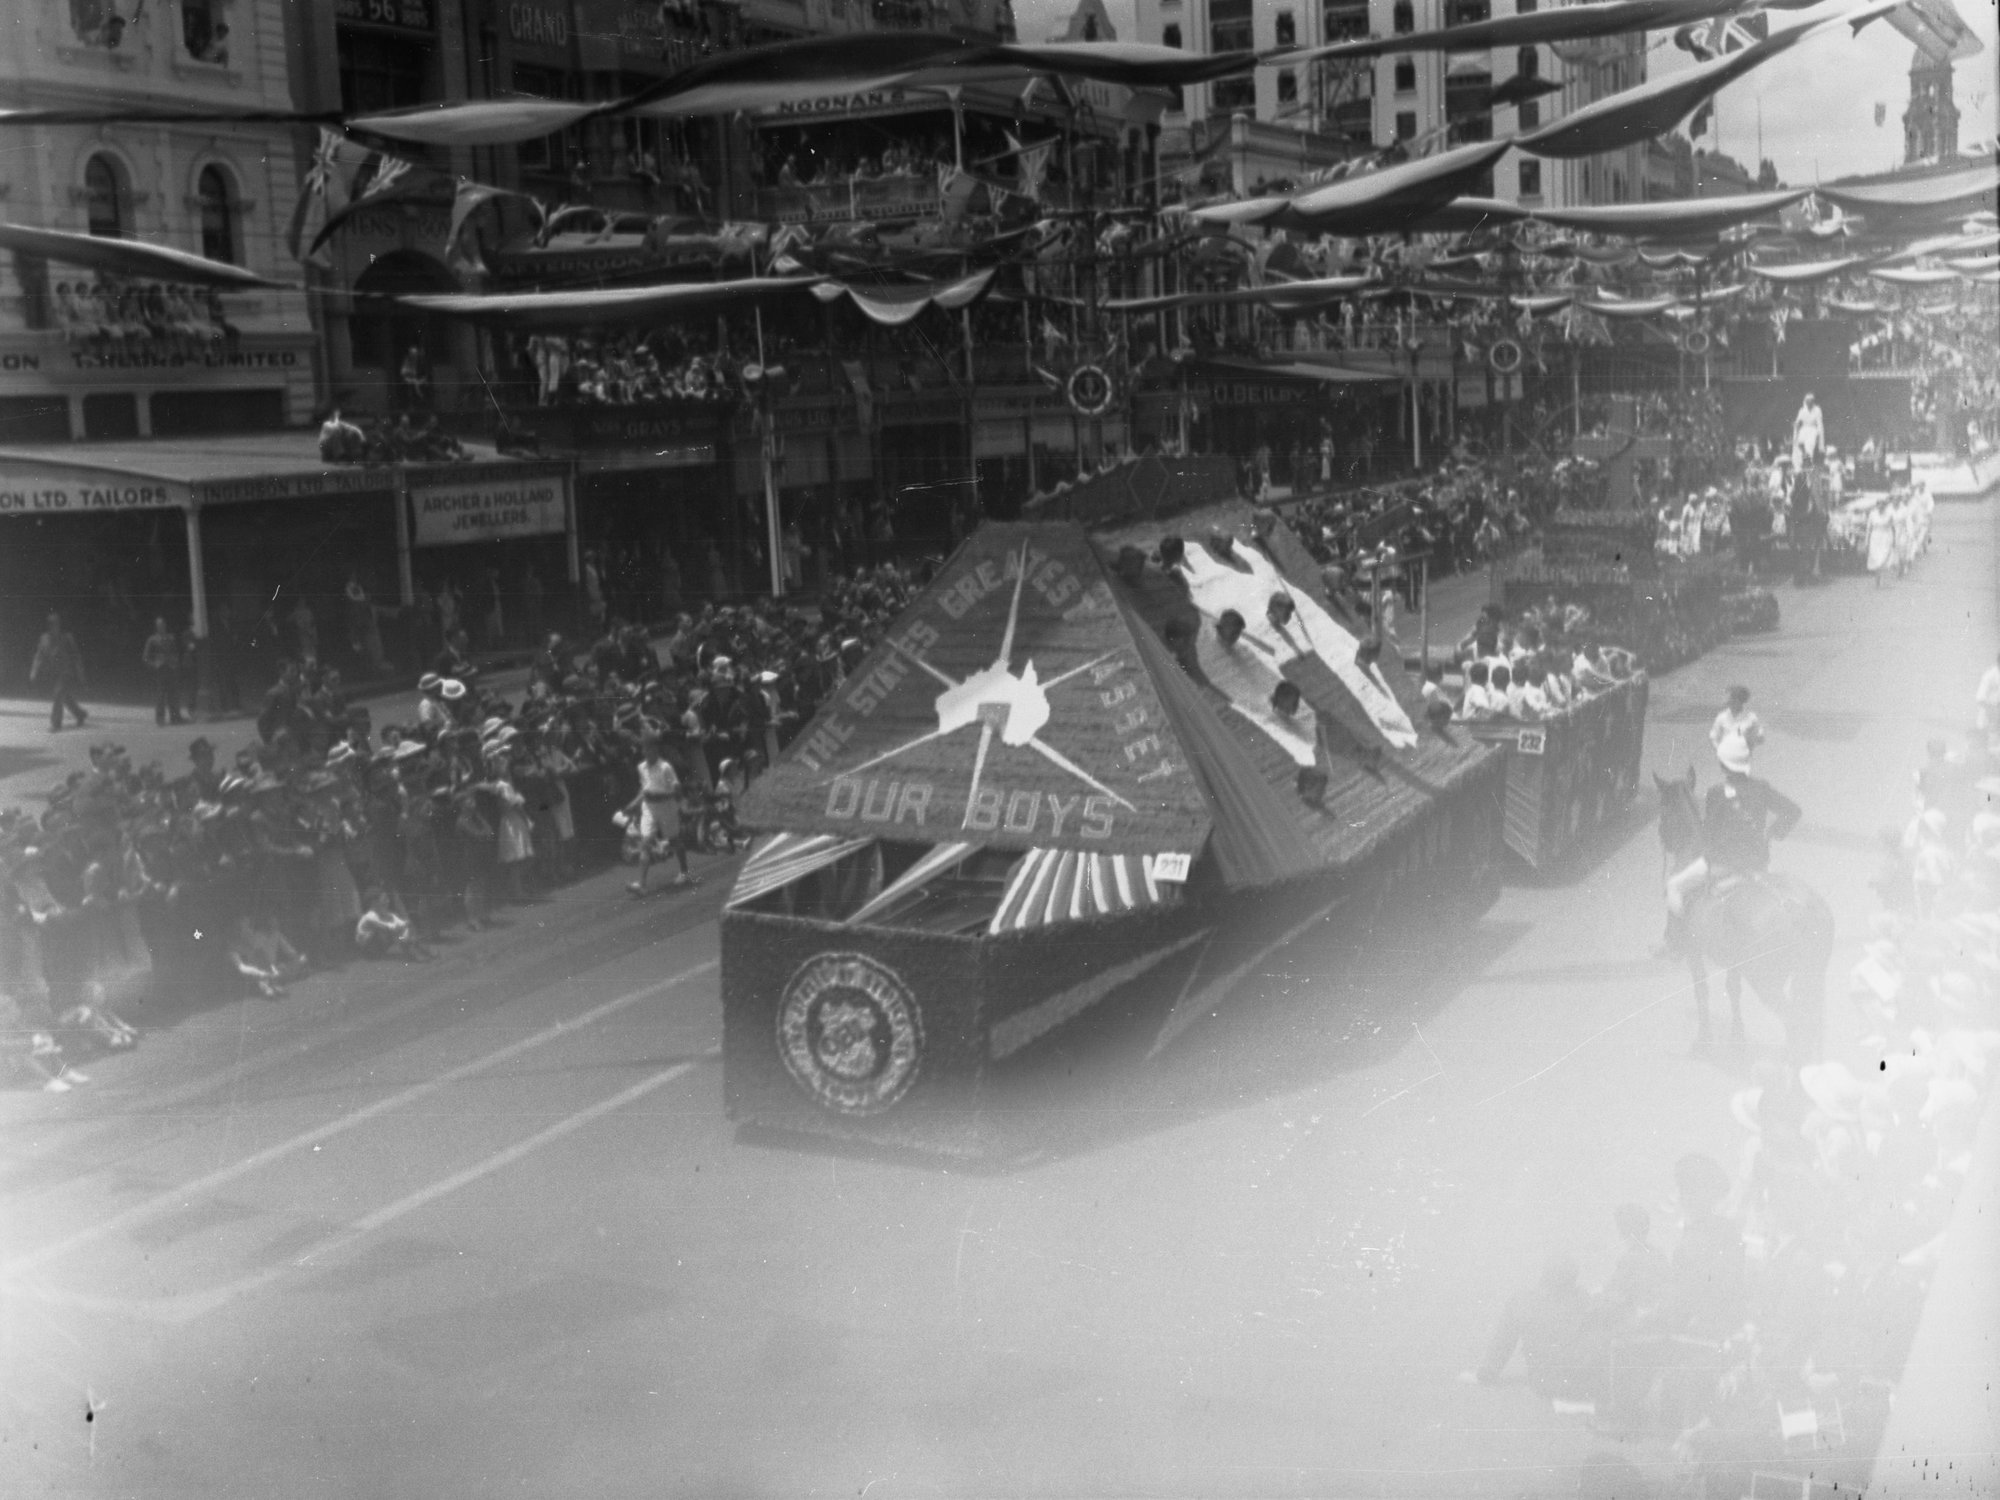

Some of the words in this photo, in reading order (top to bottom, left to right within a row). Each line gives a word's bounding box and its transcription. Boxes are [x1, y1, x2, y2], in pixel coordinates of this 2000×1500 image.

[509, 2, 567, 46] GRAND
[780, 92, 883, 114] NOONAN
[499, 256, 644, 276] AFTERNOON
[205, 350, 297, 368] LIMITED
[424, 492, 481, 513] ARCHER
[494, 487, 554, 506] HOLLAND
[792, 712, 856, 773] THE
[846, 618, 941, 718] STATES
[824, 777, 934, 826] OUR
[964, 786, 1115, 839] BOYS
